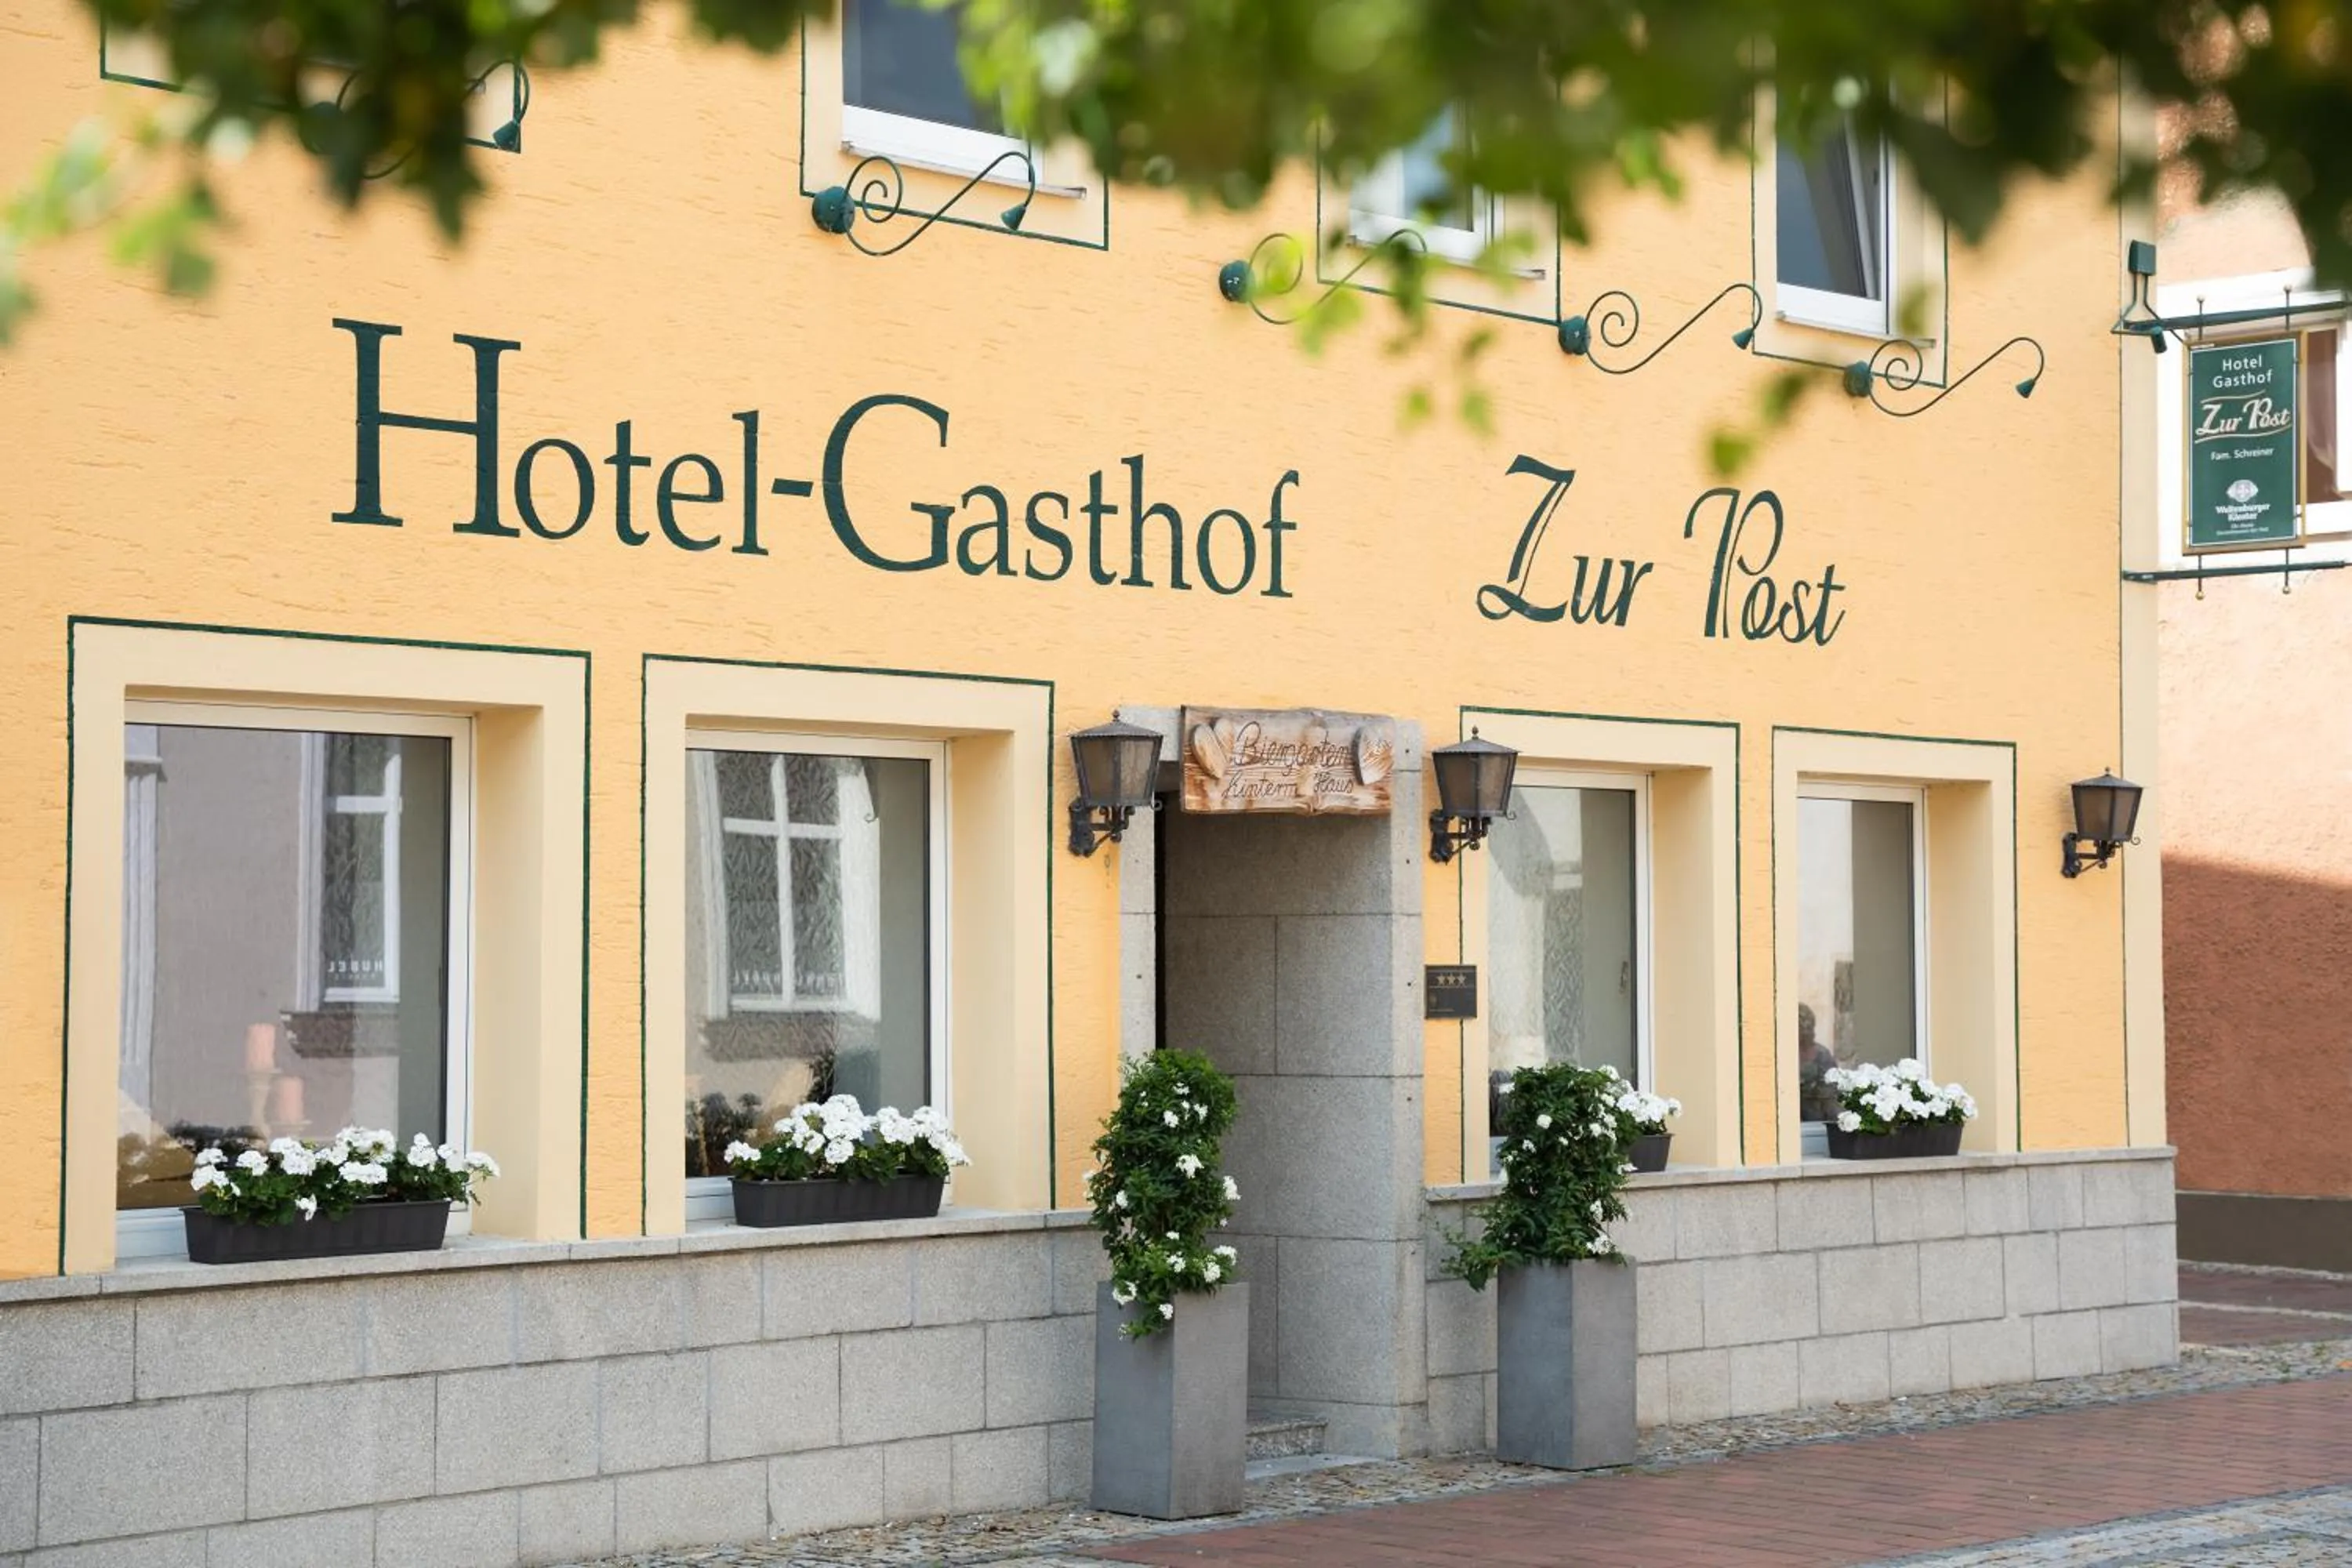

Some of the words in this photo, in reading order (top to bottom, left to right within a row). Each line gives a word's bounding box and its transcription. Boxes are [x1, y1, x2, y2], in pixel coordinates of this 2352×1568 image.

[2223, 355, 2263, 371] Hotel
[2212, 369, 2273, 388] Gasthof
[2195, 403, 2243, 435] Zur
[2243, 397, 2292, 430] Post
[331, 318, 1302, 599] Hotel-Gasthof
[2211, 451, 2230, 461] Fam.
[2234, 447, 2274, 459] Schreiner
[1476, 454, 1654, 627] Zur
[1683, 487, 1846, 647] Post
